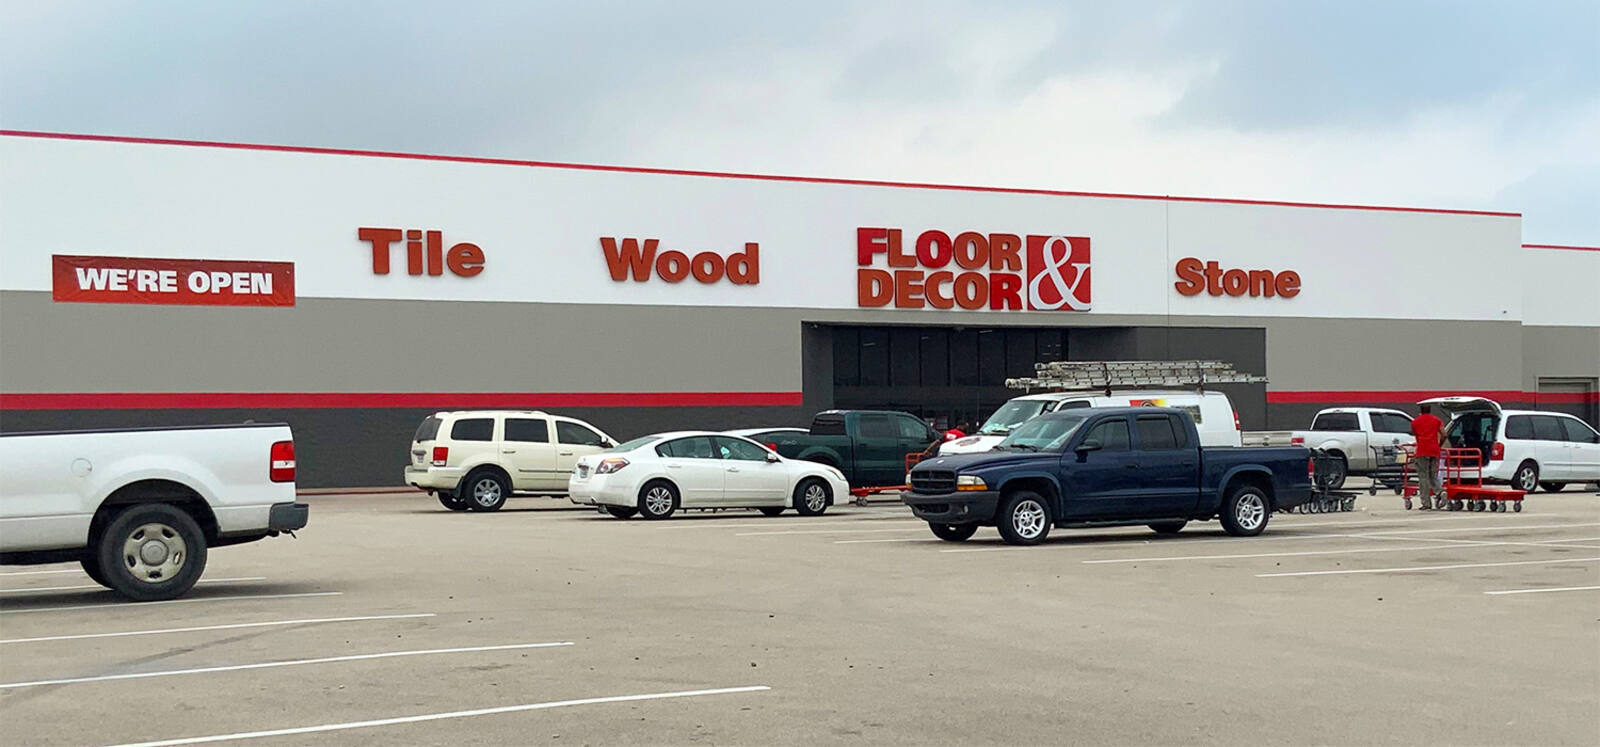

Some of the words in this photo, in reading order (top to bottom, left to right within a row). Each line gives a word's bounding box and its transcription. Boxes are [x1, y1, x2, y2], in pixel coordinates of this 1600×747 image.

[358, 227, 485, 277] Tile
[600, 237, 760, 285] Wood
[857, 227, 1022, 271] FLOOR
[75, 267, 178, 293] WE'RE
[187, 270, 273, 295] OPEN
[857, 268, 1022, 311] DECOR
[1029, 236, 1091, 311] &
[1175, 257, 1301, 298] Stone
